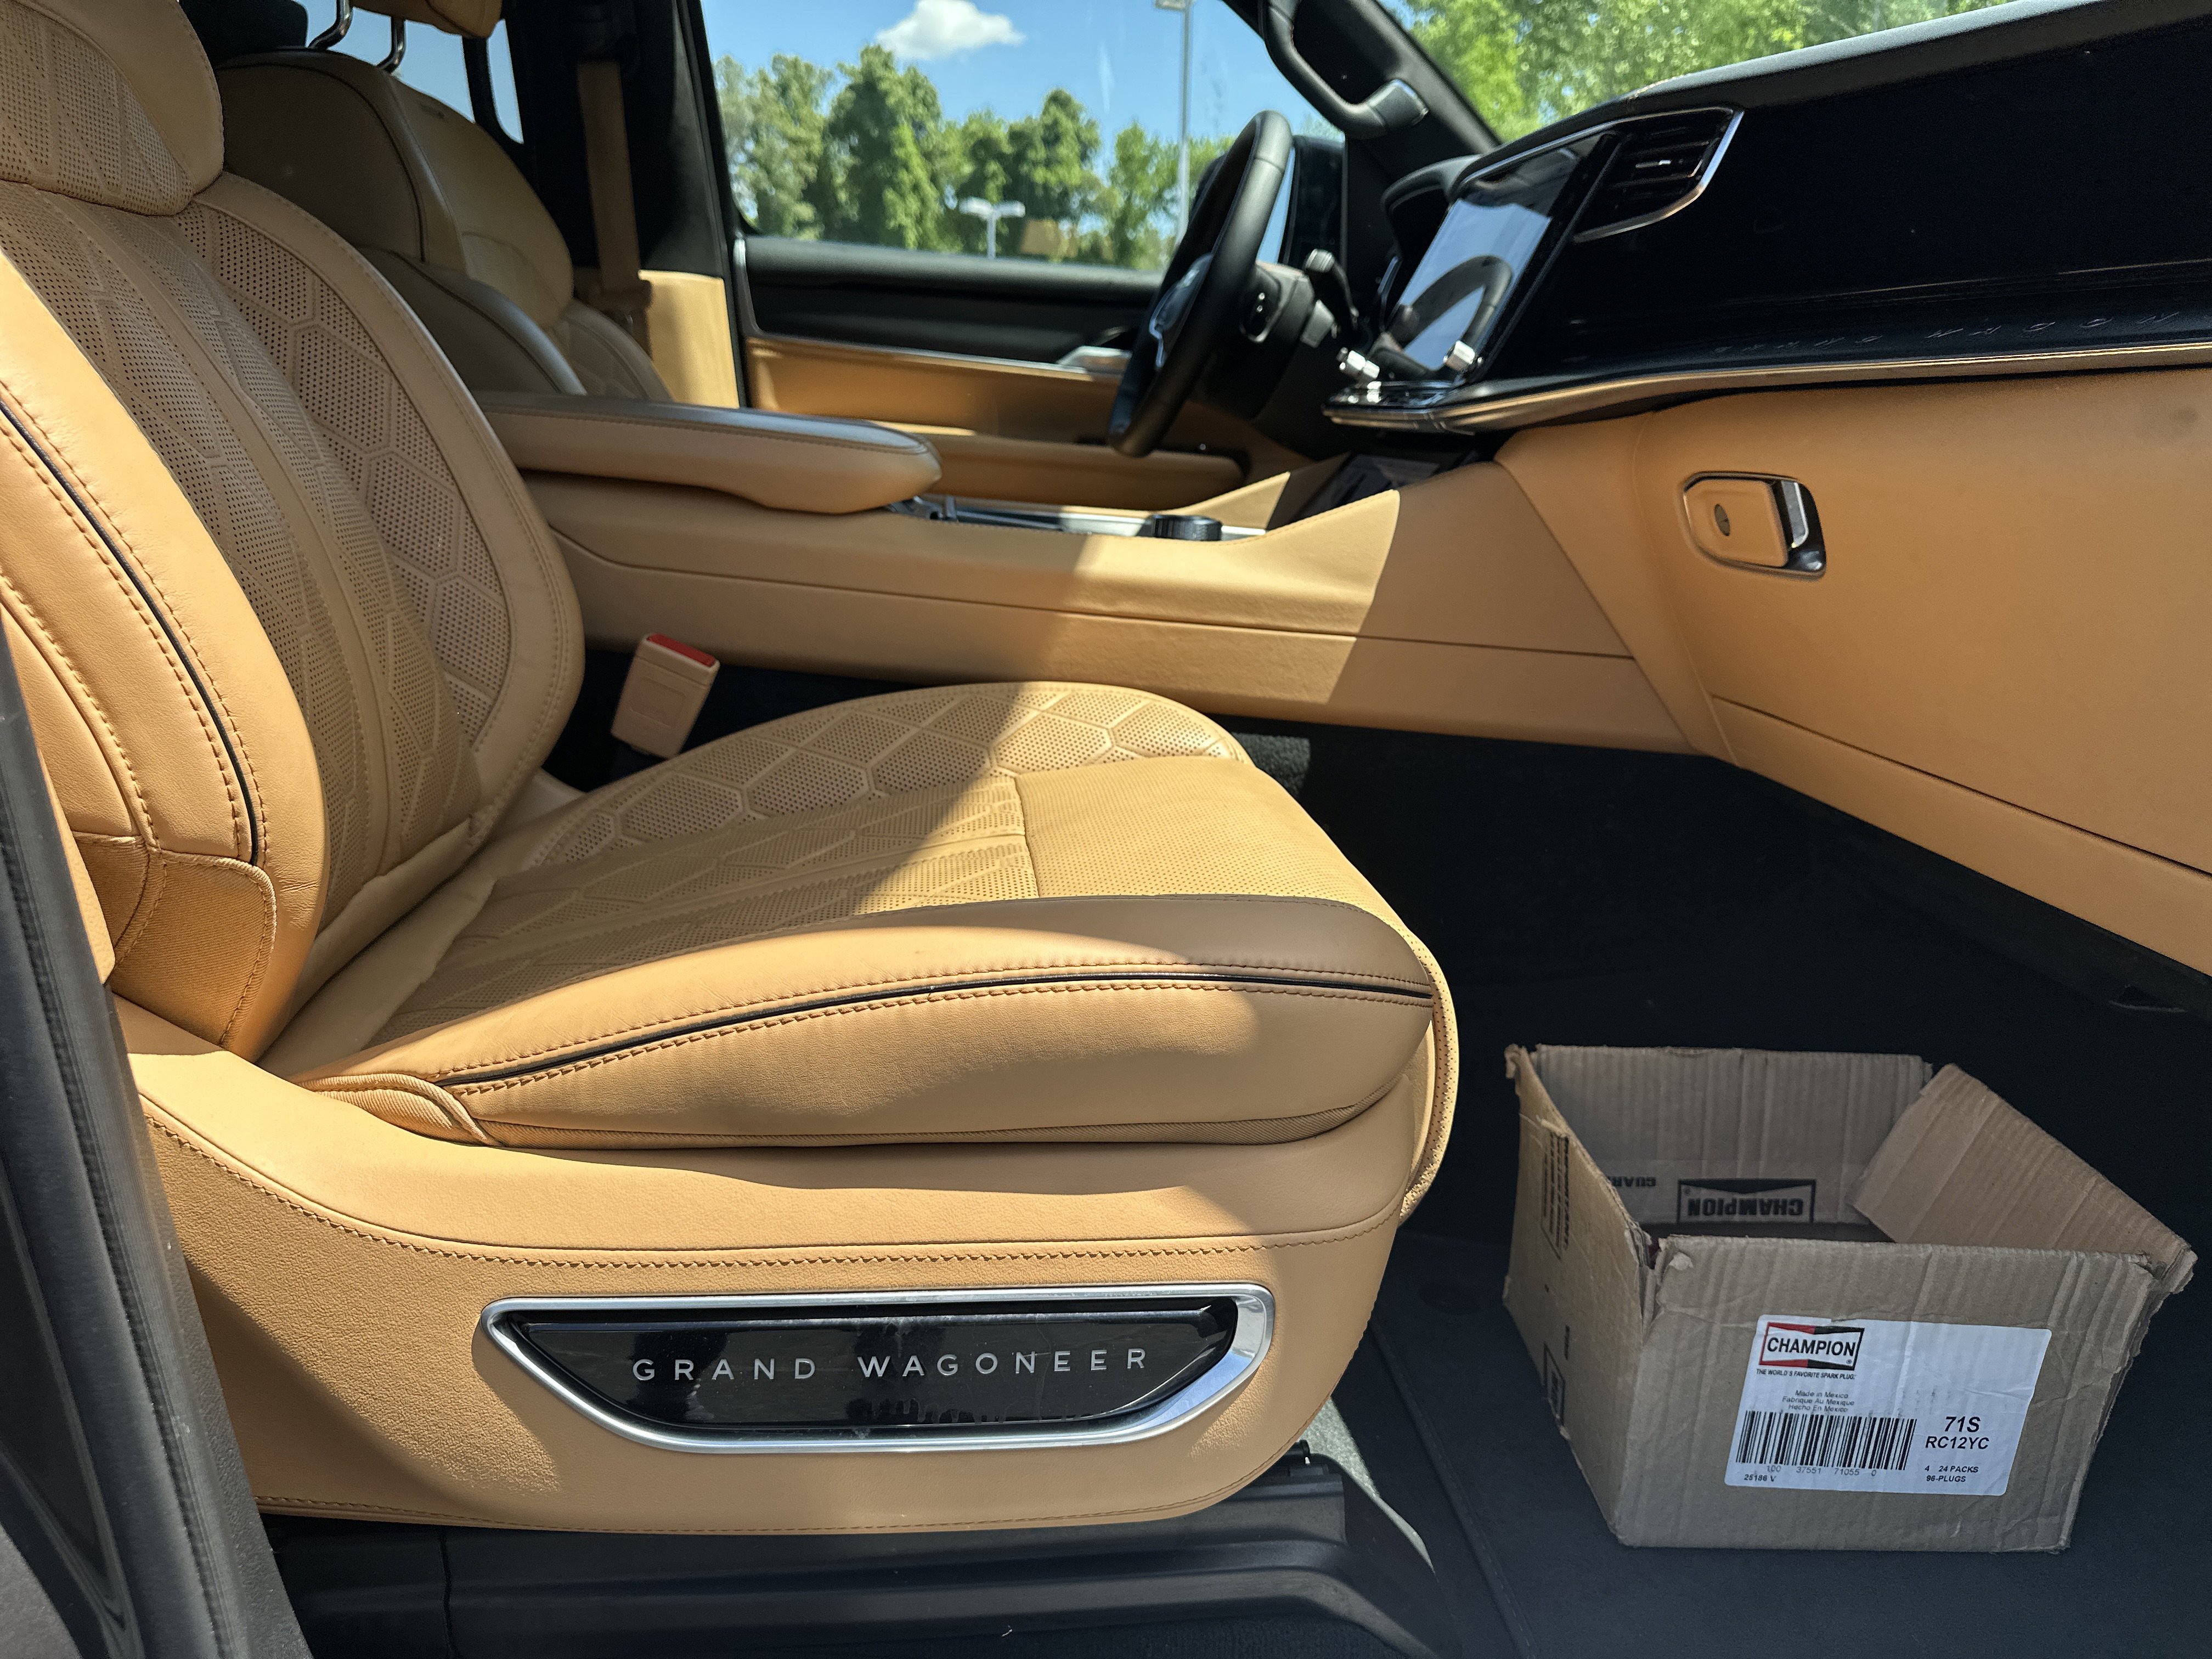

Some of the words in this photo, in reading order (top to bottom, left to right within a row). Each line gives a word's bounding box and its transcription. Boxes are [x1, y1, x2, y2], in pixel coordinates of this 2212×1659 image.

[1688, 1198, 1804, 1216] CHAMPION
[1767, 1337, 1857, 1356] CHAMPION
[633, 1357, 816, 1381] GRAND
[857, 1348, 1146, 1378] WAGONEER
[1782, 1396, 1813, 1404] Fabrique
[1826, 1398, 1854, 1407] Mexique
[1944, 1416, 1981, 1432] 71S
[1925, 1436, 1989, 1449] RC12YC
